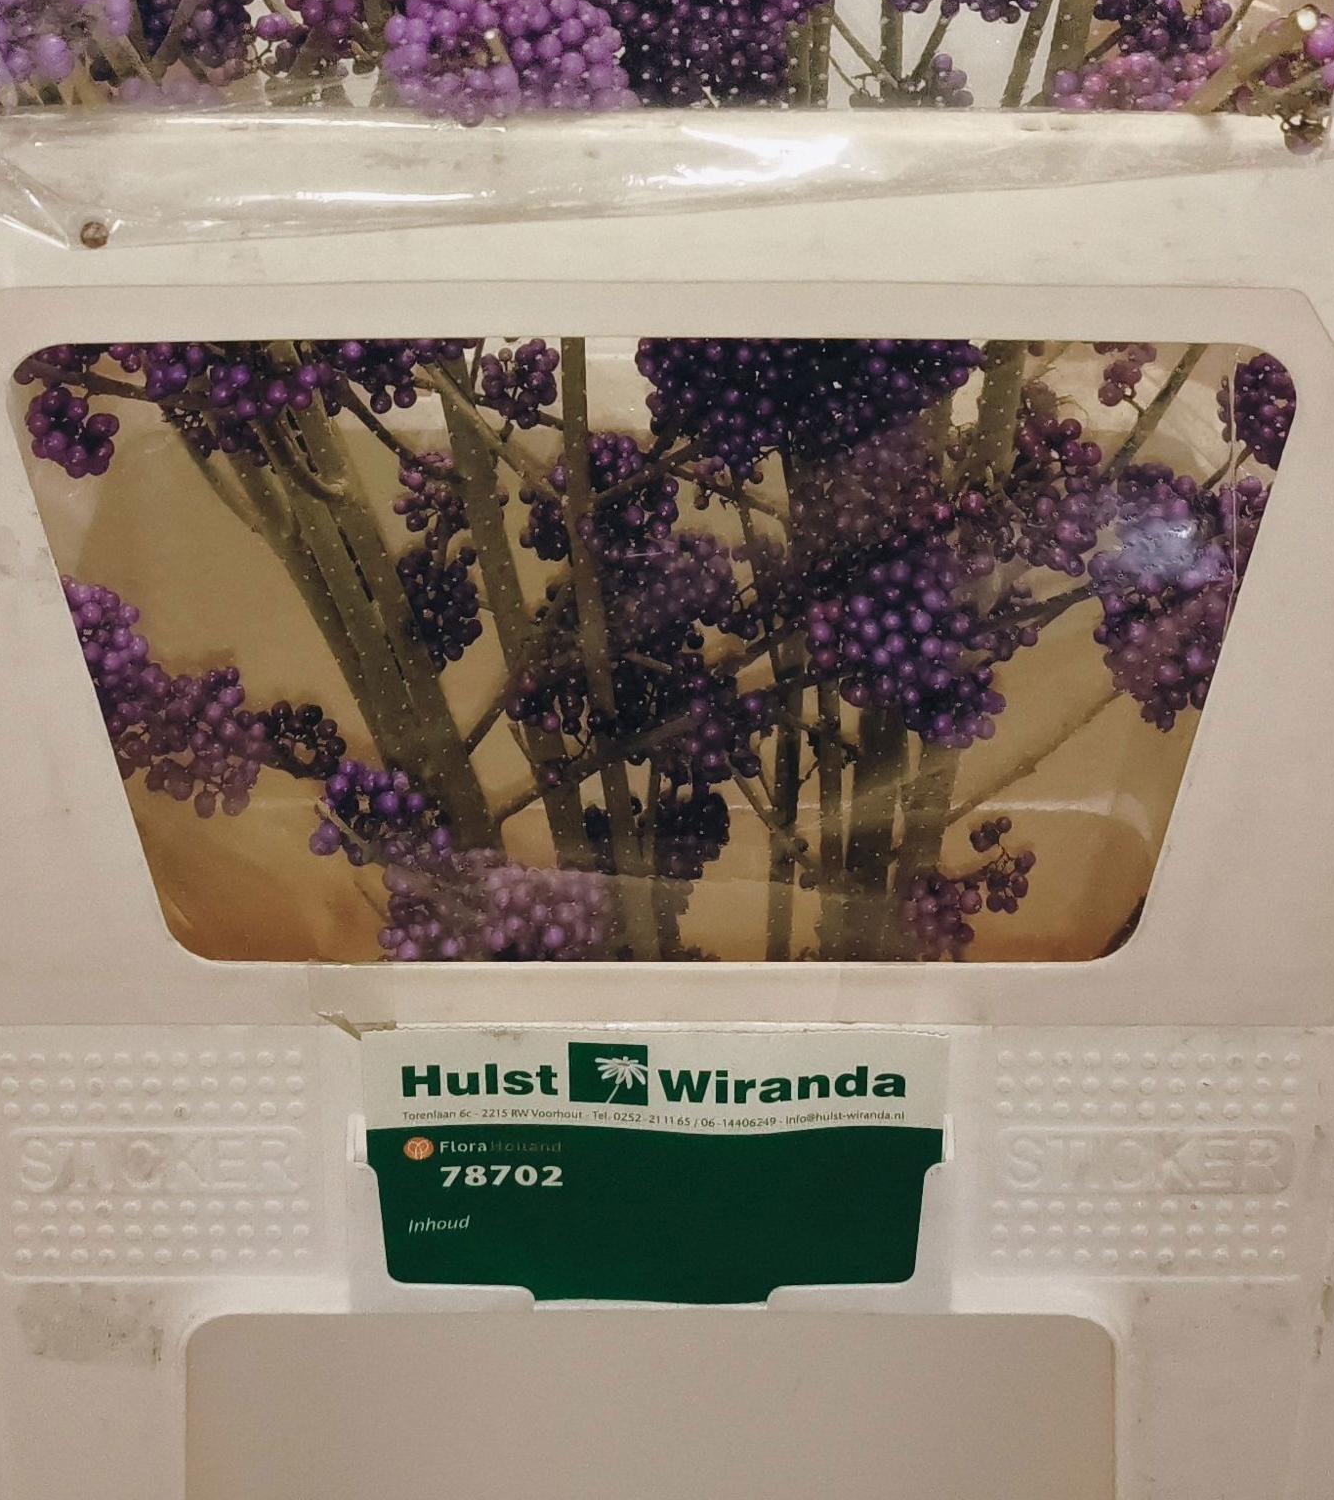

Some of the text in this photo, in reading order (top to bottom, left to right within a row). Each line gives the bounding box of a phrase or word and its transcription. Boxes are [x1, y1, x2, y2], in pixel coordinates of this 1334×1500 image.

[402, 1063, 906, 1104] Hulst Wiranda
[403, 1110, 456, 1120] Torenlaan
[459, 1108, 472, 1118] 6c
[482, 1108, 508, 1118] 2215
[511, 1109, 529, 1118] RW
[531, 1109, 582, 1119] Voorhout
[786, 1110, 904, 1125] info@hulst-wiranda.nl
[440, 1165, 563, 1187] 78702
[409, 1215, 470, 1234] Inhoud
